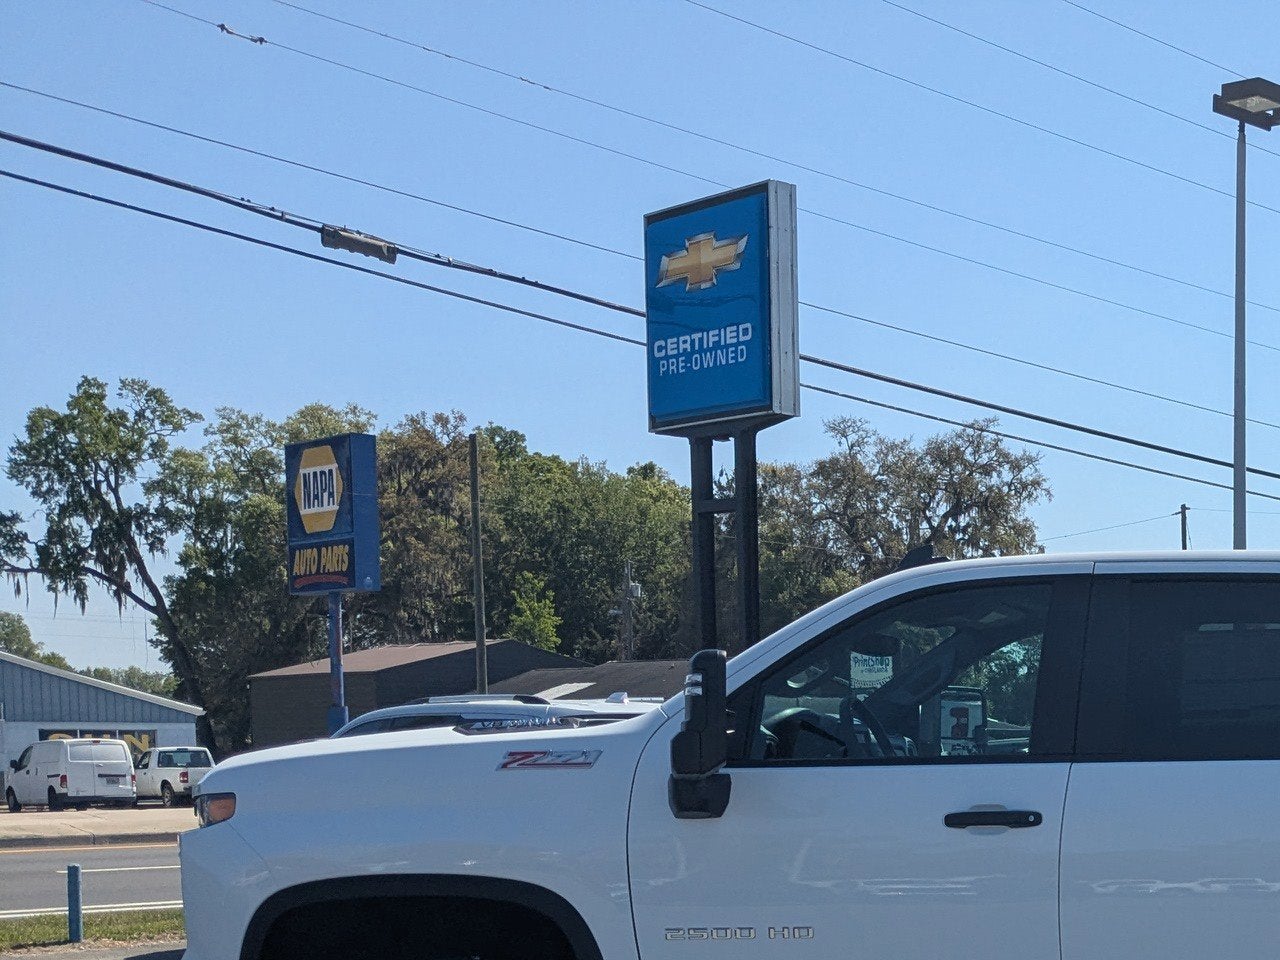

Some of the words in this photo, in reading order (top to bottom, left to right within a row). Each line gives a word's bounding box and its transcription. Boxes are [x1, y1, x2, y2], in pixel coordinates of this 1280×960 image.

[653, 322, 753, 358] CERTIFIED
[659, 345, 747, 376] PRE-OWNED
[302, 468, 336, 510] NAPA
[293, 547, 318, 576] AUTO
[320, 544, 350, 574] PARTS
[664, 926, 757, 941] 2500
[767, 926, 815, 940] HD
